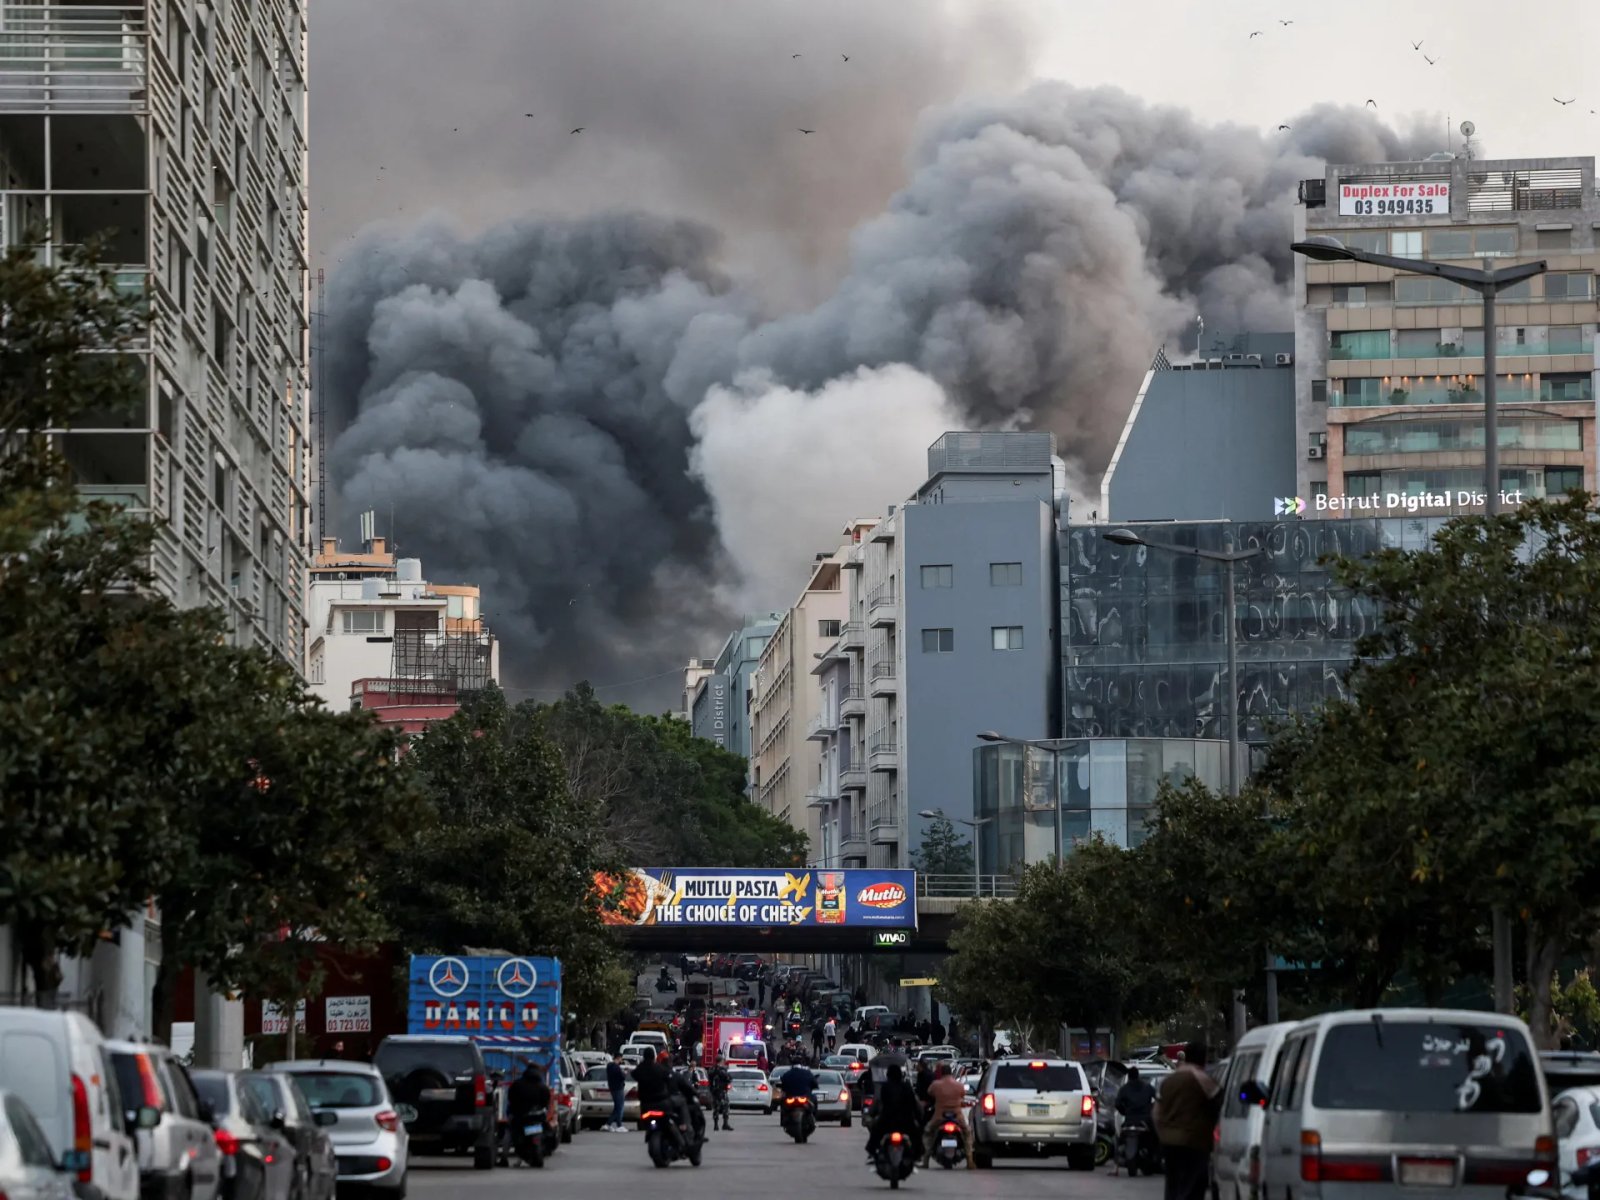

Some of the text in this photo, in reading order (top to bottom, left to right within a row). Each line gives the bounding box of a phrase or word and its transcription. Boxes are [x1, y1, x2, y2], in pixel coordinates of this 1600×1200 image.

[1343, 183, 1448, 199] Duplex For Sale
[1354, 199, 1434, 215] 03 949435
[1316, 489, 1523, 513] Beirut Digital Disict
[713, 684, 724, 728] District
[685, 879, 778, 896] MUTLU PASTA
[858, 886, 904, 903] Mutlu
[656, 905, 804, 922] THE CHOICE OF CHEFS
[263, 1020, 273, 1032] 03
[328, 1019, 370, 1031] 03 723 022
